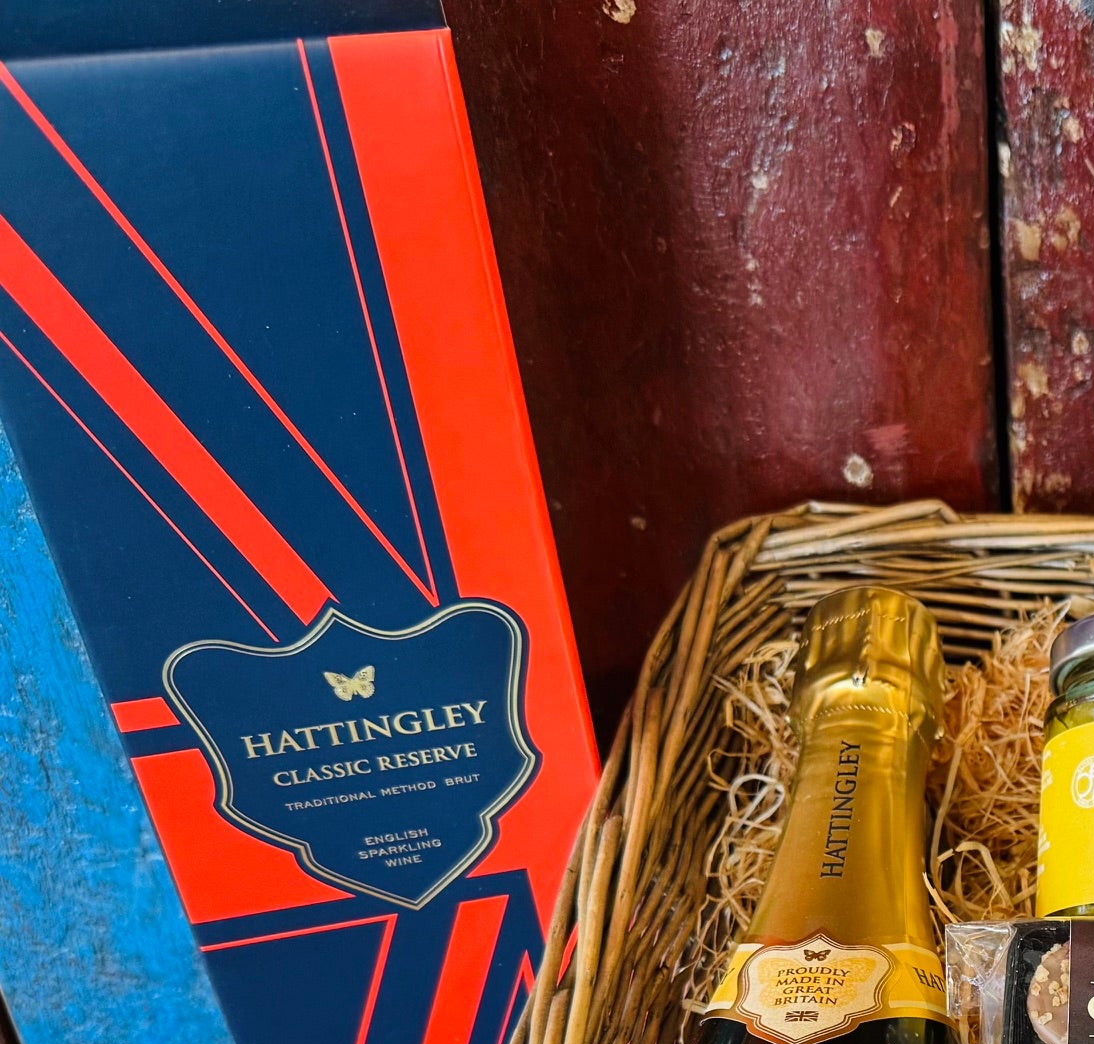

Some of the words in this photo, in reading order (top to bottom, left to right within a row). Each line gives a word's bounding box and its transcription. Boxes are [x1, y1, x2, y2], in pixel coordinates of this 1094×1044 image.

[241, 700, 487, 759] HATTINGLEY
[273, 759, 372, 787] CLASSIC
[377, 743, 478, 772] RESERVE
[285, 791, 376, 811] TRADITIONAL
[381, 781, 437, 797] METHOD
[445, 773, 480, 787] BRUT
[821, 740, 860, 878] HATTINGLEY
[364, 828, 428, 846] ENGLISH
[358, 839, 442, 860] SPARKLING
[386, 855, 422, 868] WINE
[777, 966, 850, 977] PROUDLY
[776, 976, 821, 987] MADE
[826, 977, 845, 987] IN
[782, 986, 834, 995] GREAT
[774, 995, 838, 1006] BRITAIN
